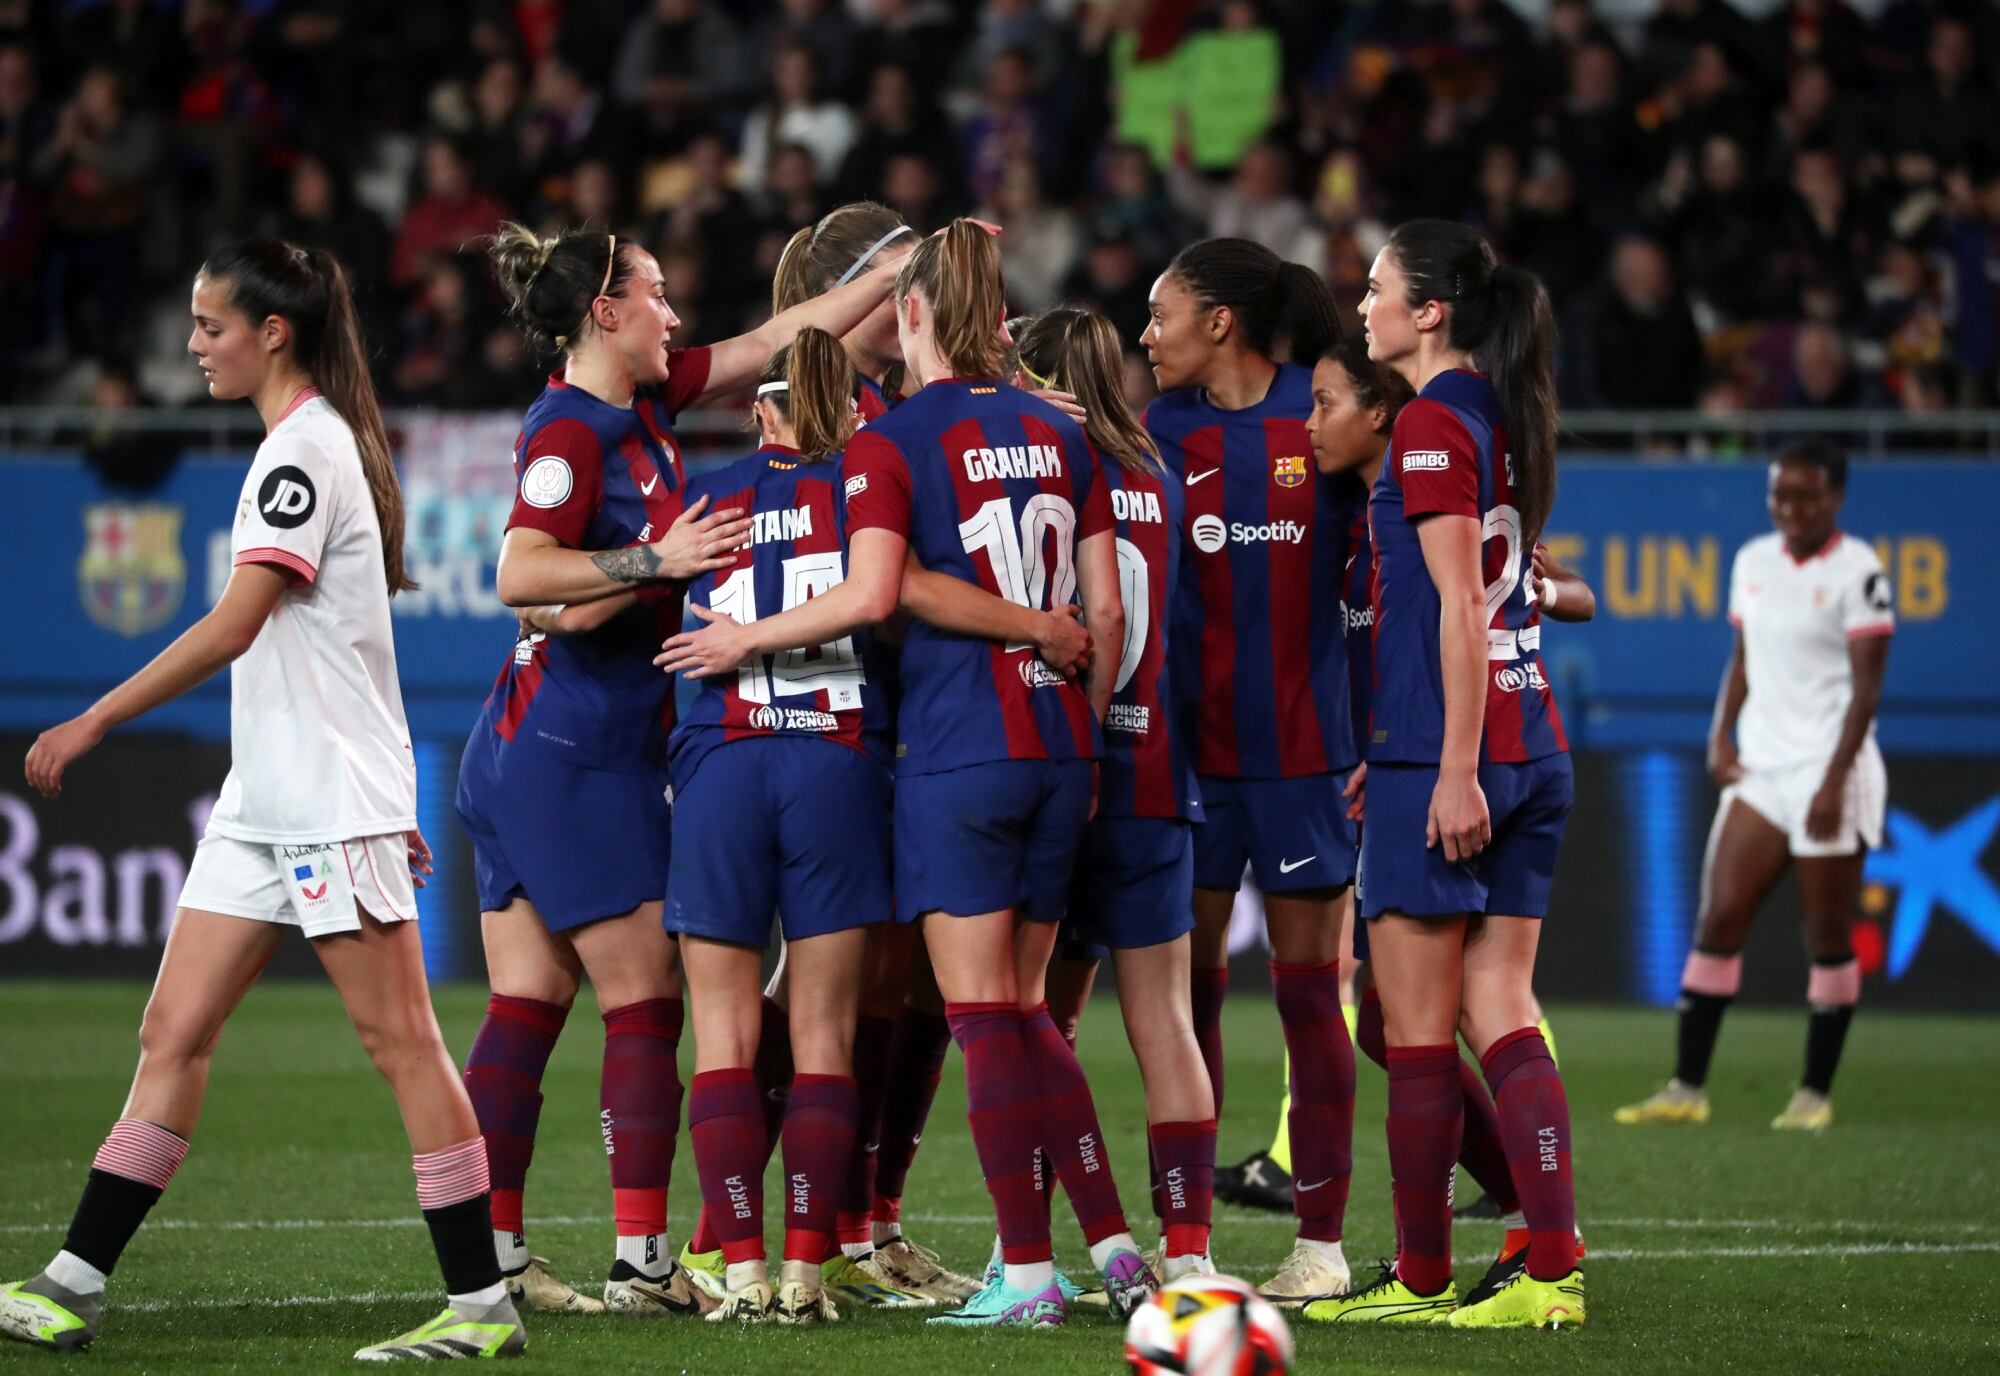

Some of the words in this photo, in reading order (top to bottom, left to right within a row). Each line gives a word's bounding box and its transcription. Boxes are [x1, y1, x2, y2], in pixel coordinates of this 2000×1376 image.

[962, 445, 1063, 483] GRAHAM
[1402, 453, 1449, 470] BIMBO
[262, 479, 311, 516] JD
[1111, 488, 1163, 524] ONA
[1230, 519, 1306, 545] Spotify
[957, 493, 1077, 653] 10
[1604, 536, 1719, 618] UN
[708, 551, 867, 710] 14
[1350, 604, 1375, 631] Spoti
[785, 716, 838, 729] ACNUR
[0, 791, 214, 947] Ban
[601, 1109, 615, 1156] BARÇA
[1079, 1132, 1100, 1174] BARÇA
[1538, 1126, 1559, 1172] BARÇA
[724, 1174, 752, 1220] BARÇA
[792, 1172, 811, 1215] BARÇA
[1167, 1166, 1187, 1210] BARÇA
